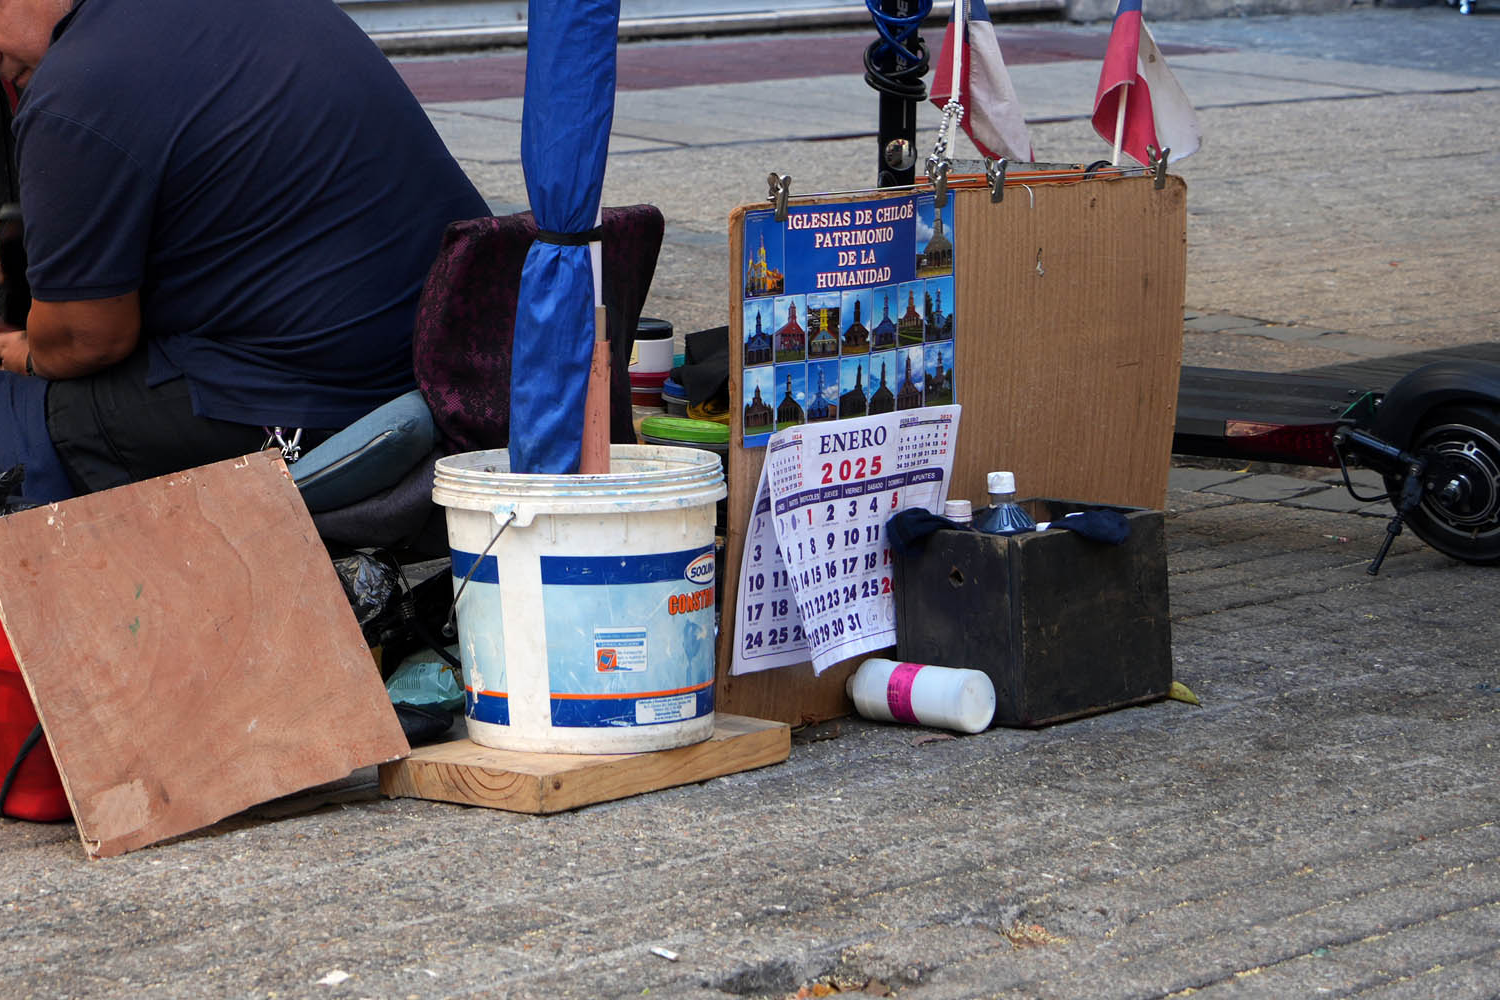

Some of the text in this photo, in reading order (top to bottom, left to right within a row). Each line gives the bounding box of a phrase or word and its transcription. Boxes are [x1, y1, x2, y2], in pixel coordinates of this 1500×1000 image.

[787, 200, 914, 230] IGLESIAS DE CHILOÉ
[814, 226, 894, 248] PATRIMONIO
[838, 249, 876, 267] DE LA
[816, 266, 891, 289] HUMANIDAD
[819, 425, 887, 455] ENERO
[821, 455, 882, 485] 2025
[912, 473, 936, 481] APUNTES
[807, 491, 898, 525] 1 2 3 4 5
[753, 544, 762, 562] 3
[798, 542, 803, 560] 7
[810, 537, 816, 555] 8
[827, 532, 835, 550] 9
[844, 527, 859, 546] 10
[866, 525, 879, 542] 11
[749, 570, 788, 592] 10 11
[800, 570, 810, 589] 14
[811, 565, 822, 585] 15
[825, 560, 837, 579] 16
[842, 557, 858, 575] 17
[864, 552, 877, 570] 18
[815, 594, 827, 614] 22
[827, 589, 840, 608] 23
[843, 584, 857, 603] 24
[861, 579, 879, 598] 25
[747, 603, 764, 622] 17
[771, 599, 788, 617] 18
[745, 631, 763, 650] 24
[768, 627, 788, 646] 25
[820, 623, 830, 643] 29
[832, 617, 844, 637] 30
[848, 612, 862, 631] 31
